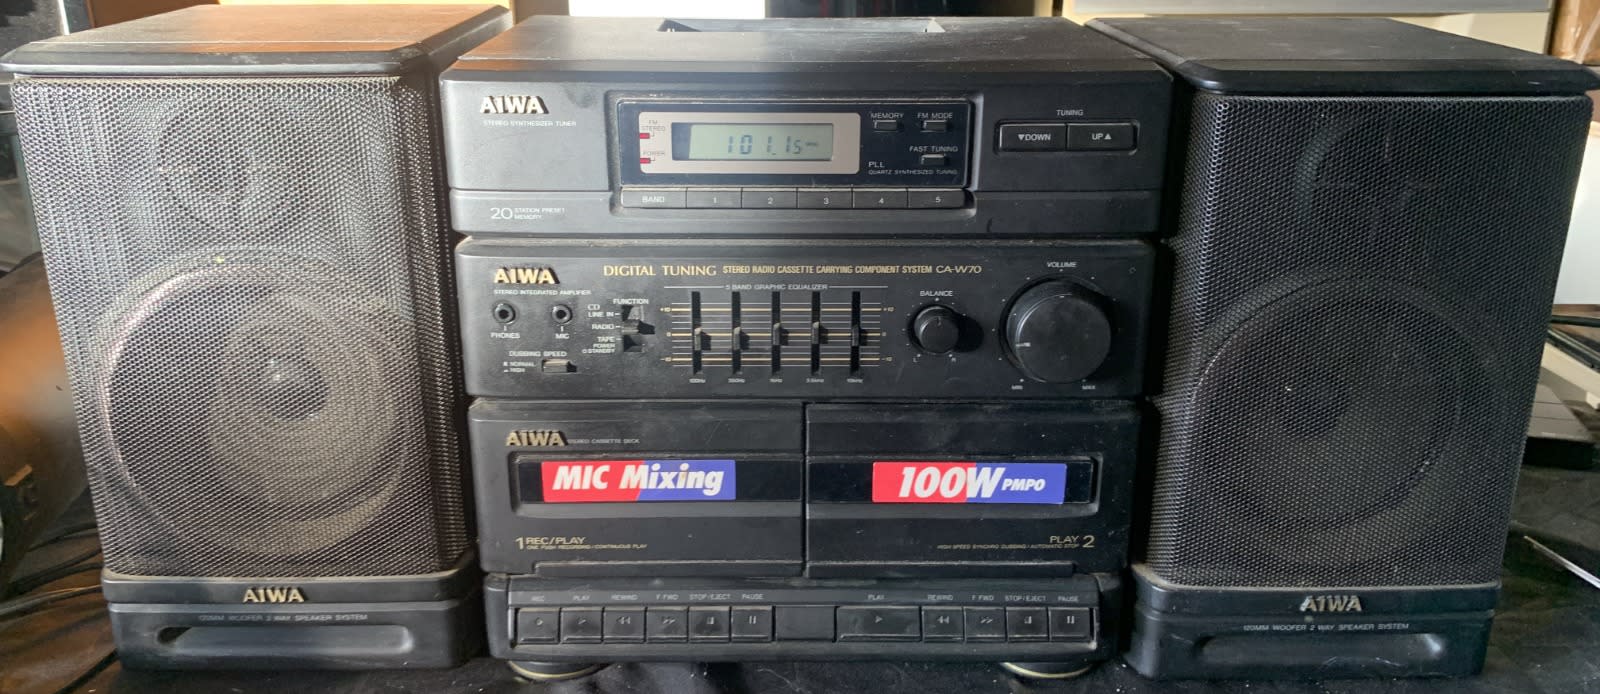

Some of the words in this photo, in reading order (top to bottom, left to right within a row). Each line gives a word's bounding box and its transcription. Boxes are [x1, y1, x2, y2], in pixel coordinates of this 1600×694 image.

[480, 95, 548, 114] AIWA
[1025, 133, 1051, 141] DOWN
[642, 195, 665, 203] BAND
[712, 196, 717, 204] 1
[767, 197, 774, 205] 2
[823, 197, 829, 205] 3
[490, 207, 513, 219] 20
[494, 267, 559, 284] AIWA
[603, 264, 656, 276] DIGITAL
[661, 264, 717, 276] TUNING
[722, 265, 750, 274] STEREO
[752, 265, 775, 274] RADIO
[777, 265, 813, 274] CASSETTE
[815, 265, 852, 274] CARRYING
[855, 265, 899, 274] COMPONENT
[902, 265, 932, 274] SYSTEM
[935, 265, 982, 274] CA-W70
[505, 430, 568, 447] AIWA
[552, 465, 611, 490] MIC
[618, 462, 725, 496] Mixing
[898, 466, 1006, 498] 100W
[1001, 478, 1047, 491] PMPO
[515, 537, 524, 550] 1
[525, 536, 586, 545] REC/PLAY
[1050, 535, 1080, 543] PLAY
[1082, 535, 1096, 548] 2
[243, 586, 306, 603] AIWA
[1300, 595, 1363, 612] AIWA
[1338, 623, 1375, 631] SPEAKER
